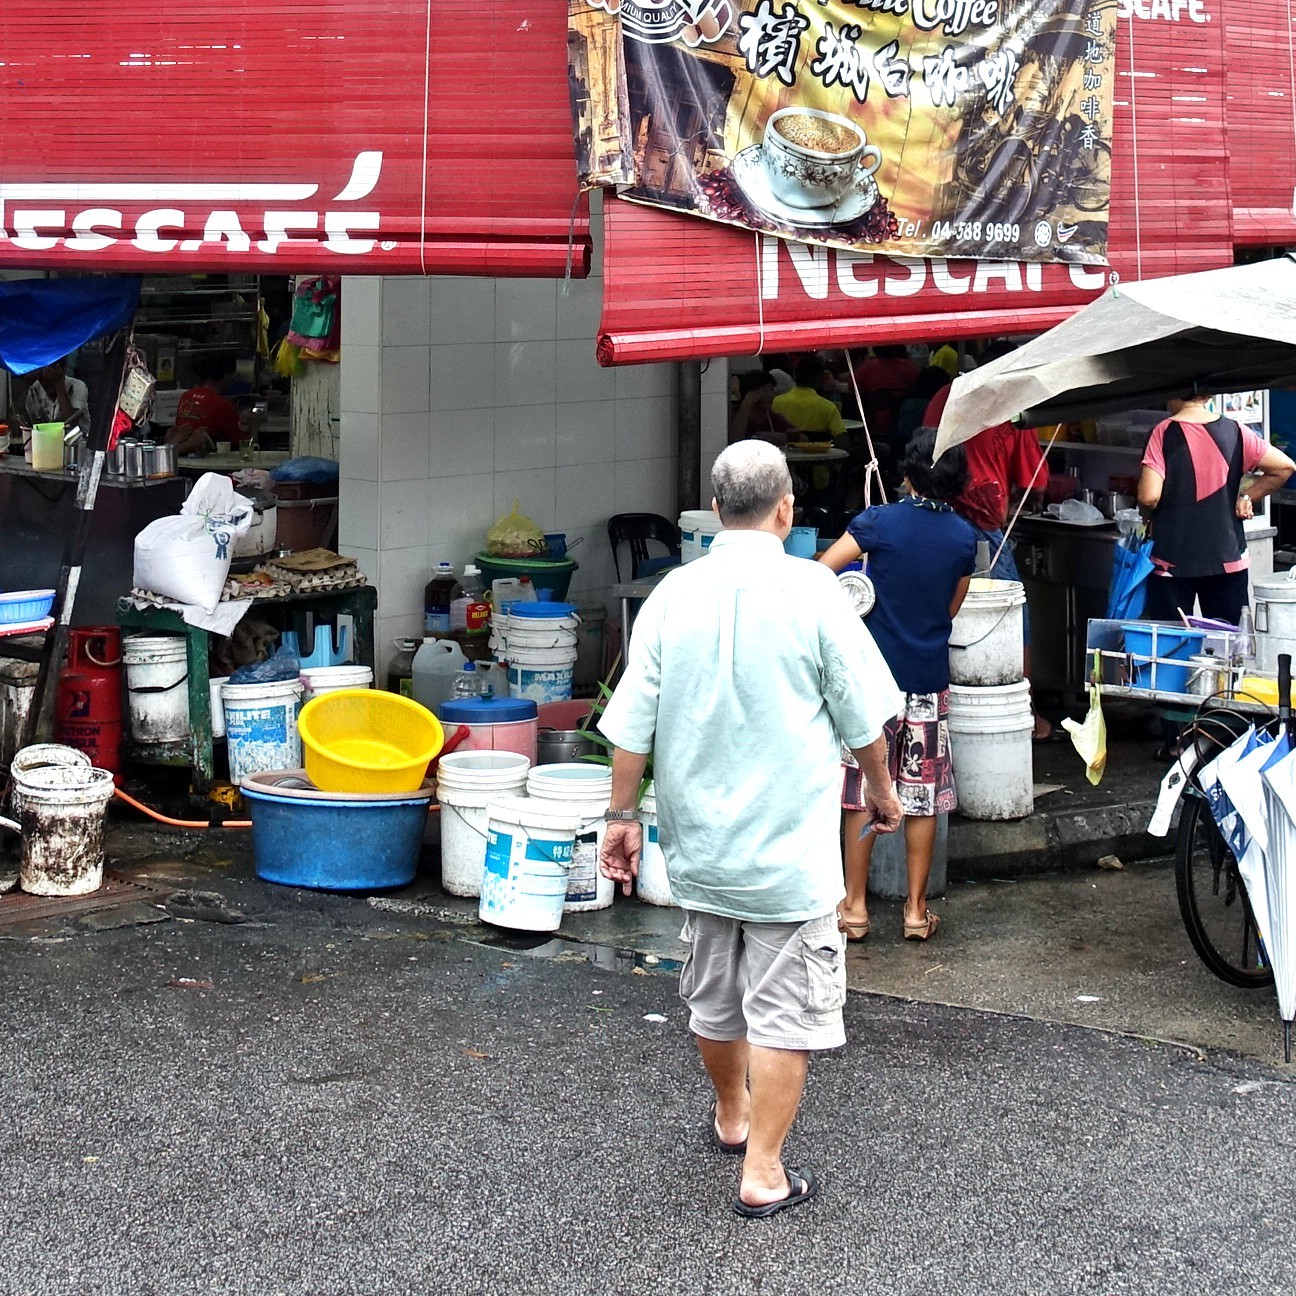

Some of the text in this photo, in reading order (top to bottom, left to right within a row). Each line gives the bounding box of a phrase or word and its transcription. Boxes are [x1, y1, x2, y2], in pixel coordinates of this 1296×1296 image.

[643, 1, 678, 23] QUALITY
[1078, 12, 1104, 150] 道地咖啡香
[897, 218, 927, 240] Tel.
[985, 222, 1020, 243] 9699
